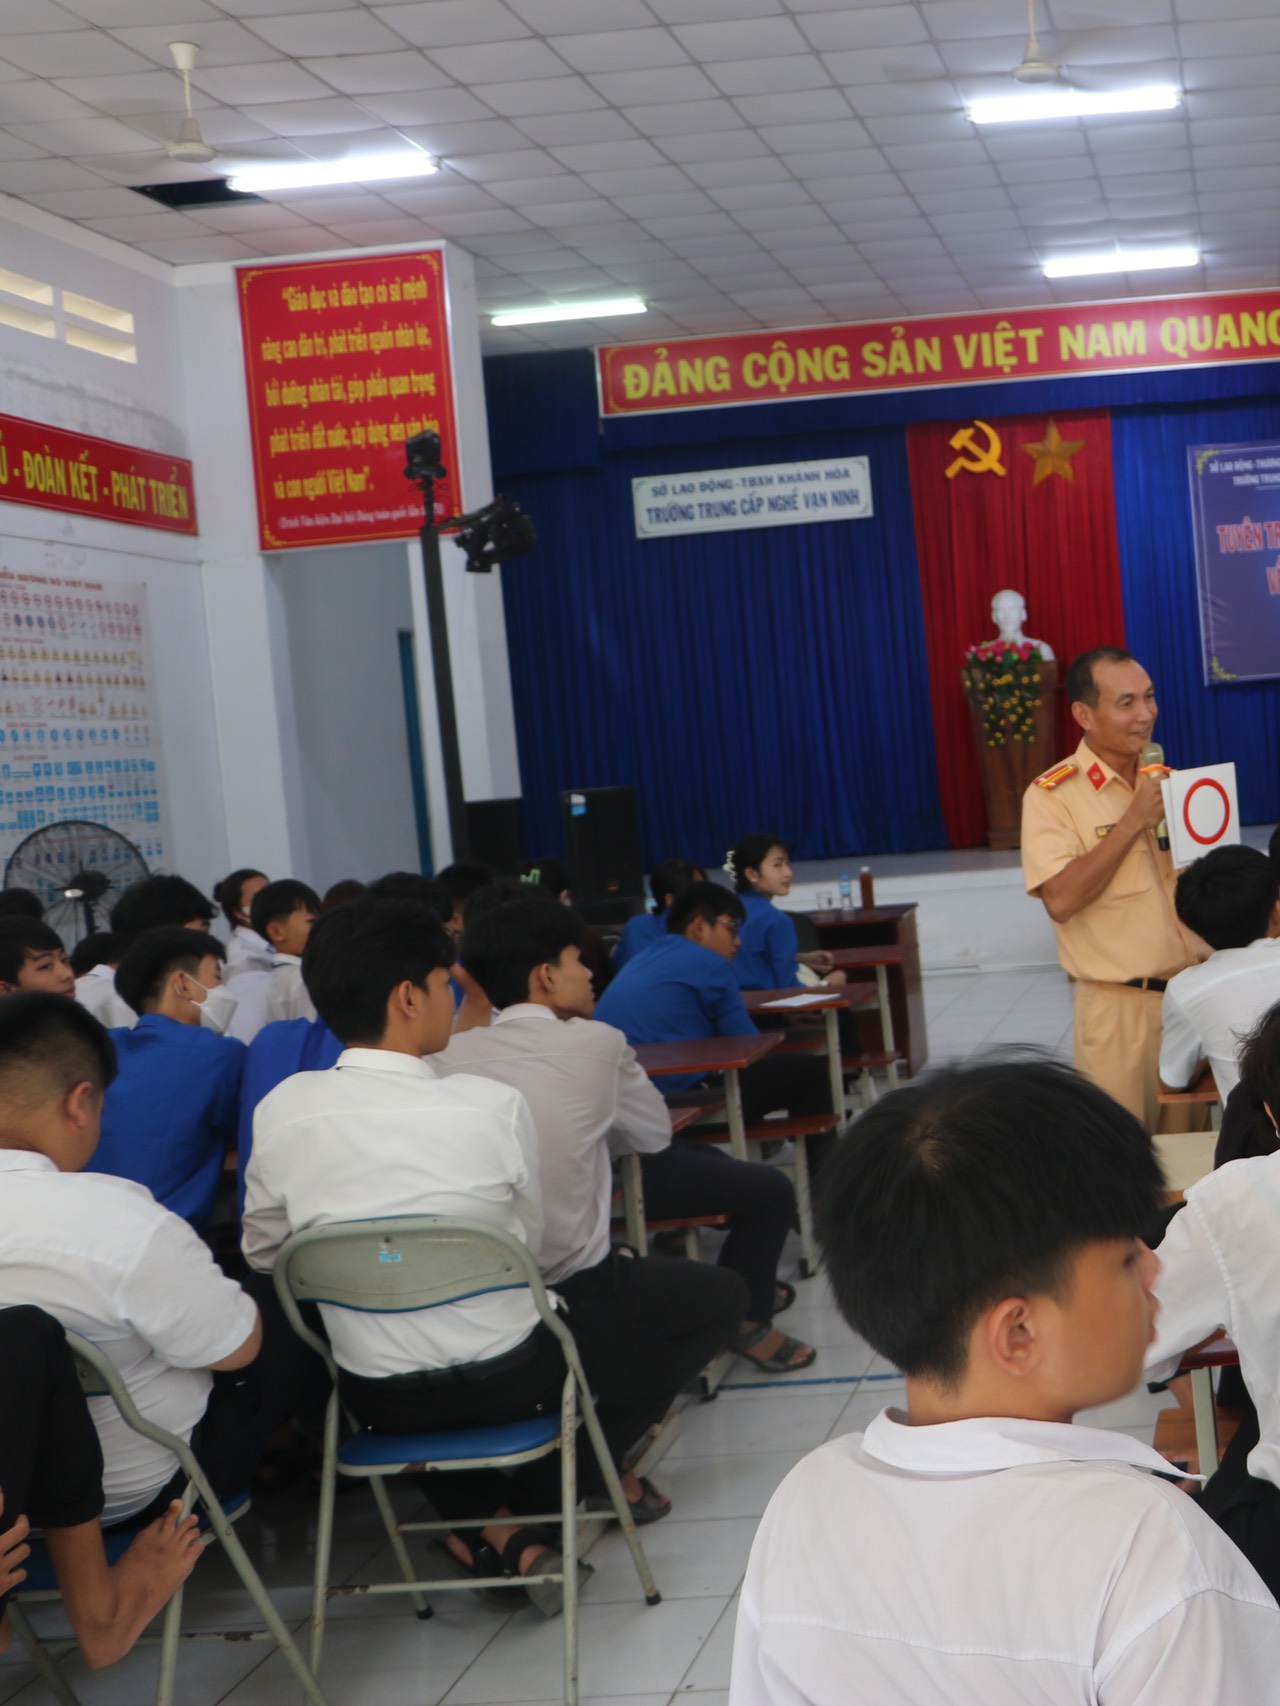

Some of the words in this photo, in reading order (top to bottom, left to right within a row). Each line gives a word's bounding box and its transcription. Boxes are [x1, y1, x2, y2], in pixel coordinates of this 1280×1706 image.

[623, 347, 730, 399] ĐẢNG
[742, 340, 850, 392] CỘNG
[861, 326, 942, 378] SẢN
[953, 321, 1044, 374] VIỆT
[1058, 319, 1147, 361] NAM
[22, 444, 68, 496] ĐOÀN
[69, 450, 98, 502] KẾT
[110, 465, 146, 512] PHÁT
[149, 466, 189, 519] TRIỂN
[646, 500, 695, 524] TRƯỜNG
[698, 501, 737, 519] TRUNG
[740, 490, 764, 515] CẤP
[767, 486, 799, 512] NGHỀ
[803, 492, 828, 512] VẠN
[831, 488, 860, 506] NINH
[1216, 516, 1263, 554] TUYÊN
